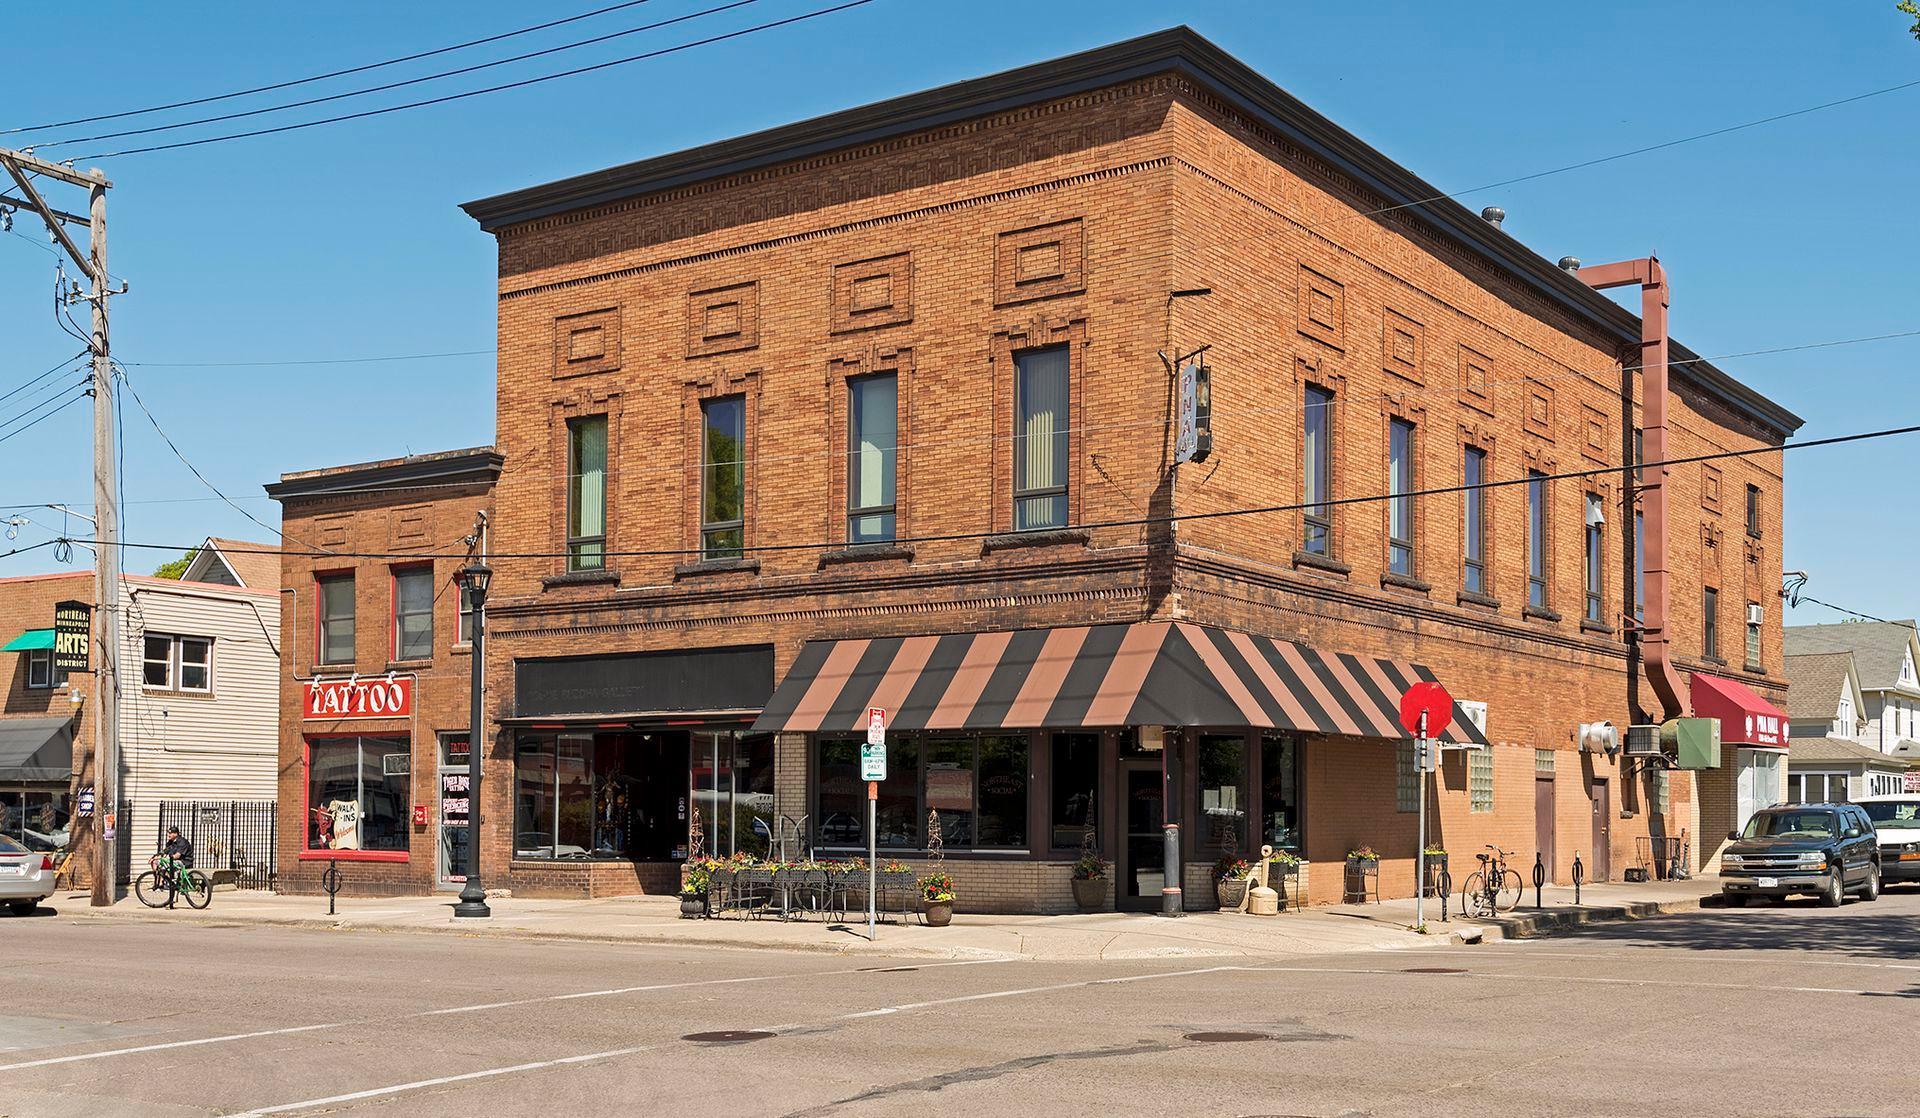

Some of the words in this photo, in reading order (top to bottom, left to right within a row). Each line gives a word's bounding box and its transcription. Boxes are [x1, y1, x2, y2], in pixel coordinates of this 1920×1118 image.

[55, 632, 89, 655] ARTS
[56, 659, 87, 668] DISTRICT
[309, 683, 404, 714] TATTOO
[1757, 714, 1767, 733] PNA
[1767, 716, 1779, 735] HALL
[80, 802, 93, 810] SHOP
[336, 803, 355, 813] WALK
